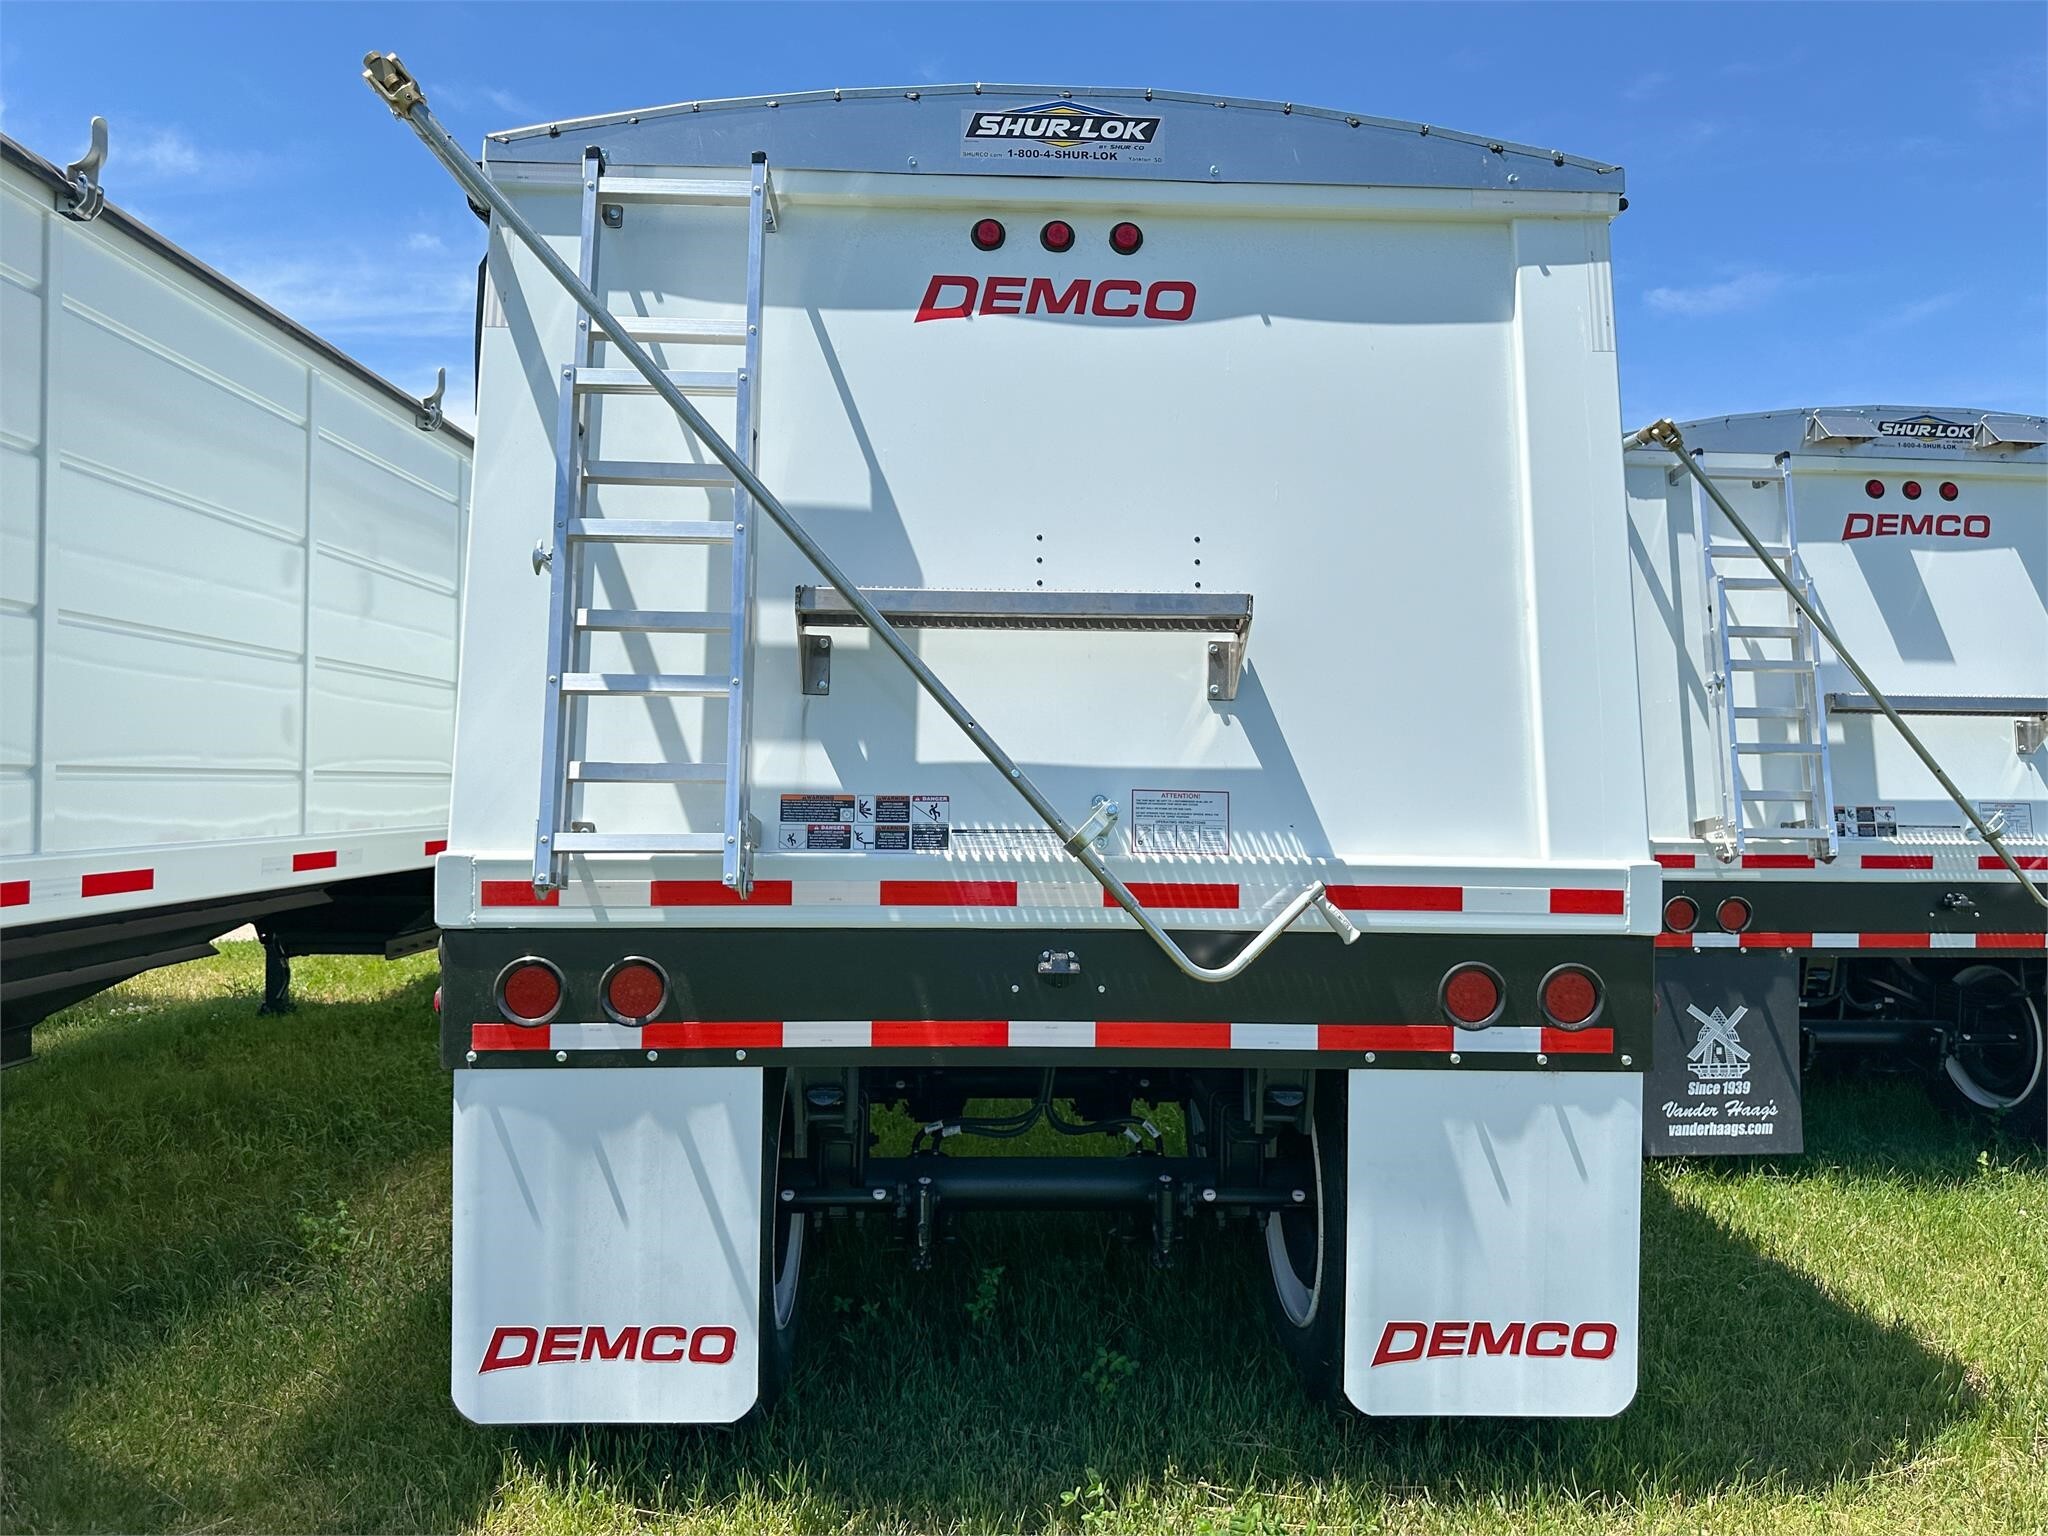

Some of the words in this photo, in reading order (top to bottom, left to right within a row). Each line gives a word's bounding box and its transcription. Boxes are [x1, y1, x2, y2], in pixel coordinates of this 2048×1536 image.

[975, 116, 1151, 141] SHUR-LOK
[1007, 149, 1118, 161] 1-800-4-SHUR-LOK
[914, 275, 1197, 323] DEMCO
[1881, 423, 1974, 438] SHUR-LOK
[1897, 442, 1957, 450] 1-800-4-SHUR-LOK
[1842, 512, 1991, 541] DEMCO
[1687, 1081, 1721, 1095] Since
[1722, 1081, 1751, 1095] 1939
[1662, 1101, 1719, 1118] Vander
[1724, 1100, 1778, 1120] Haag's
[1668, 1122, 1774, 1137] vanderhaags.com
[478, 1326, 737, 1374] DEMCO
[1371, 1322, 1617, 1367] DEMCO
